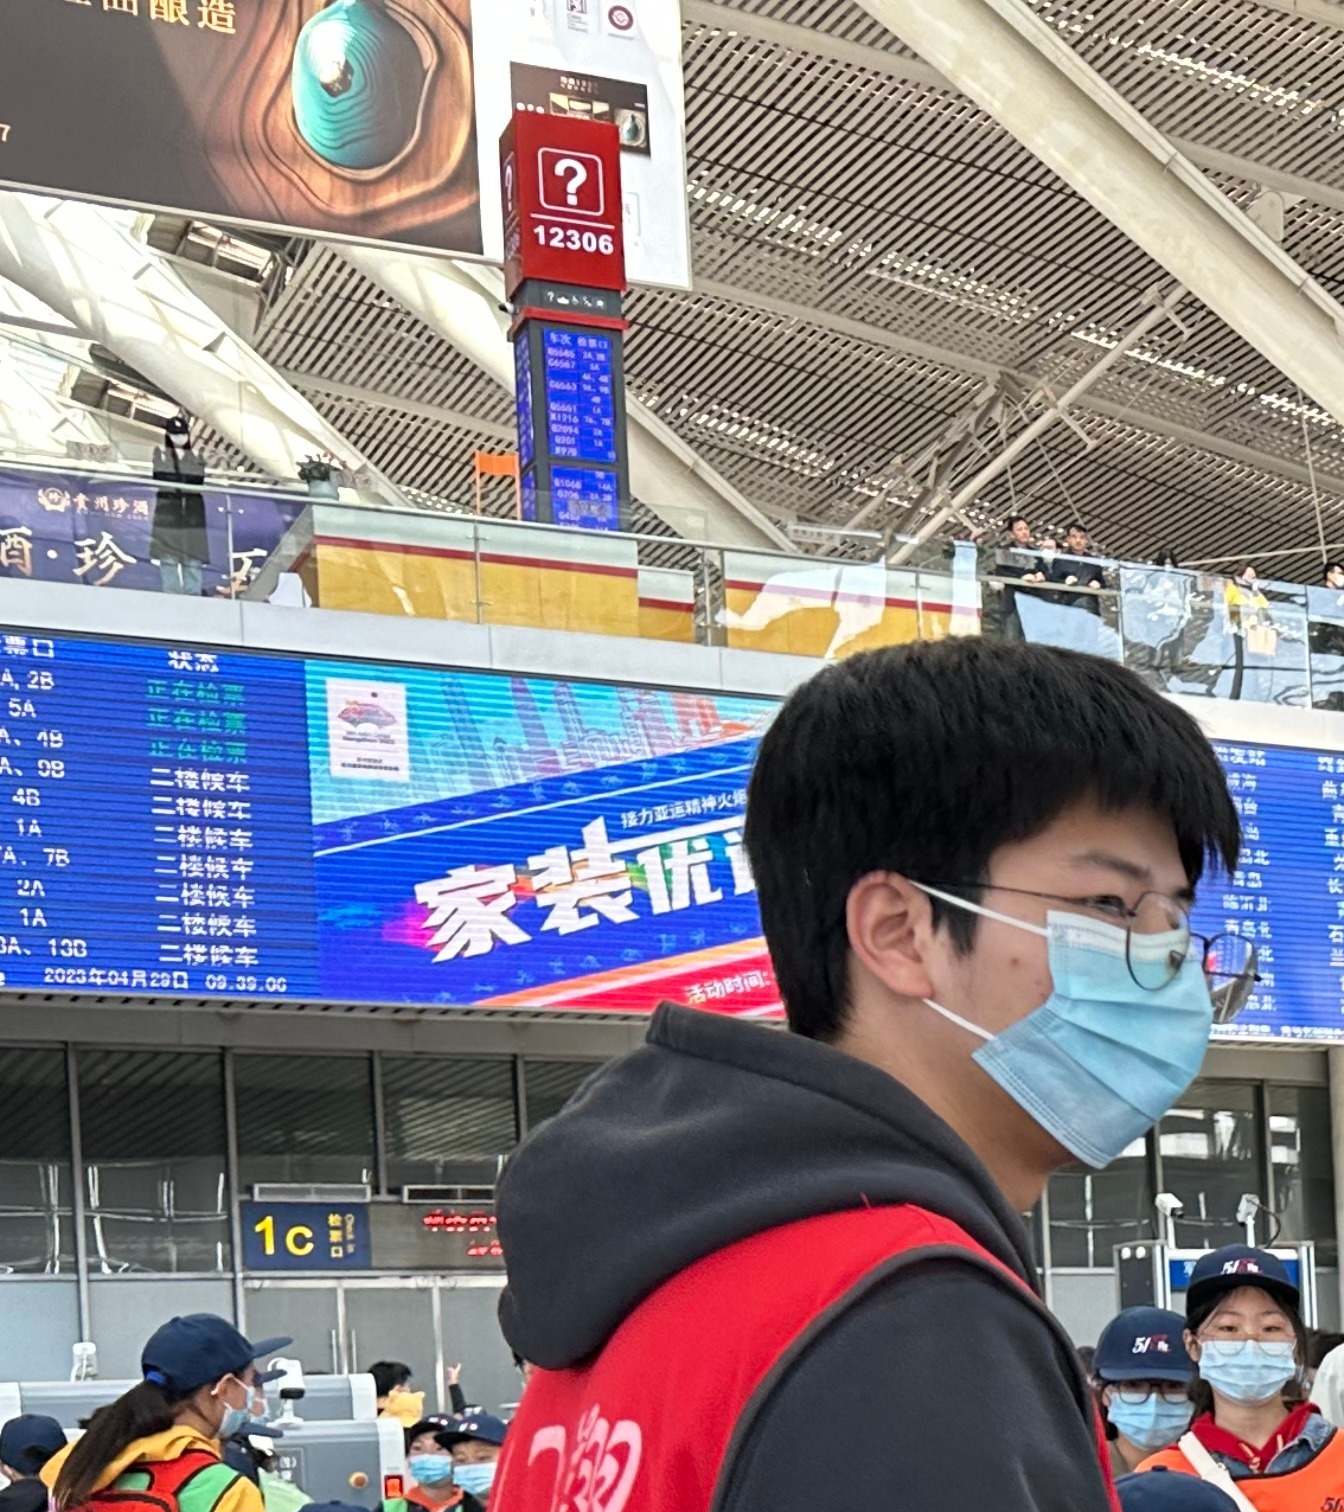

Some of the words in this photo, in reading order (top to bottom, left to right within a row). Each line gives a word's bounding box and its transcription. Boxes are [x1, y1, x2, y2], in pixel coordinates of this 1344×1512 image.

[533, 225, 614, 255] 12306
[0, 635, 54, 658] 票口
[168, 651, 219, 672] 状态
[8, 698, 36, 717] 5A
[16, 818, 42, 837] 1A
[17, 880, 45, 897] 2A
[20, 908, 47, 927] 1A
[328, 1213, 344, 1258] 检票口
